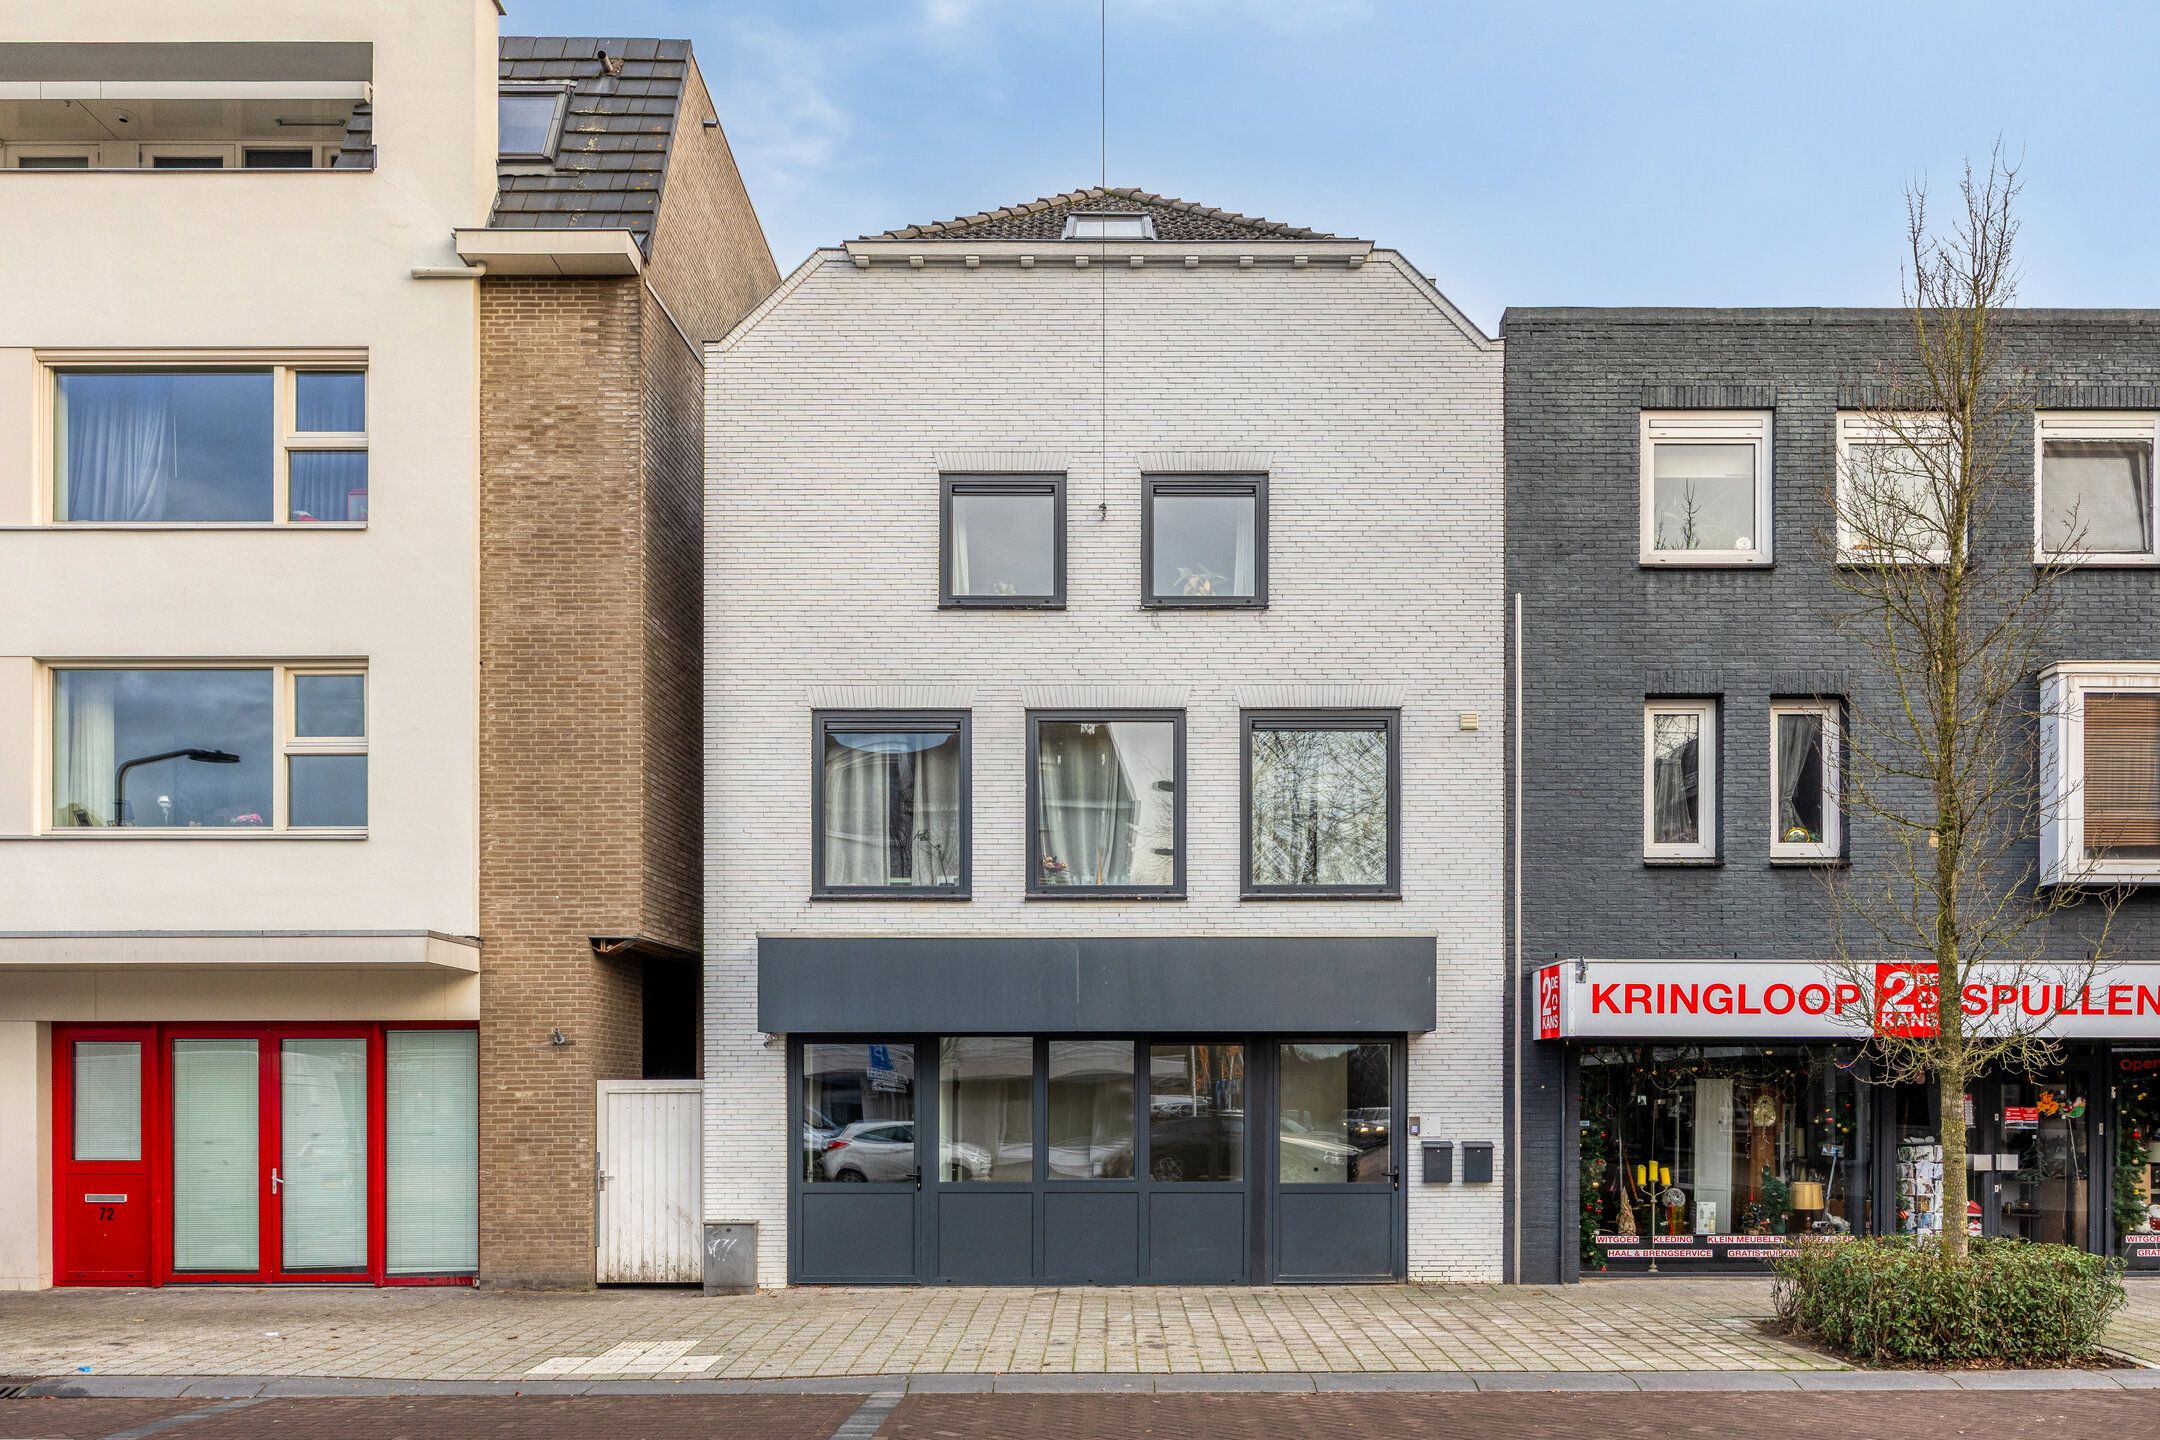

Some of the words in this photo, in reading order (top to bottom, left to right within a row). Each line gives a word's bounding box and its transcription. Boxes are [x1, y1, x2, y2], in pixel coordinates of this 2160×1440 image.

[1542, 976, 1552, 1016] 2
[1551, 975, 1559, 989] DE
[1591, 982, 1862, 1015] KRINGLOOP
[1882, 971, 1915, 1012] 2
[1960, 983, 2160, 1016] SPULLEN
[1541, 1014, 1559, 1030] KANS
[1881, 1012, 1940, 1027] KANS
[99, 1207, 114, 1221] 72
